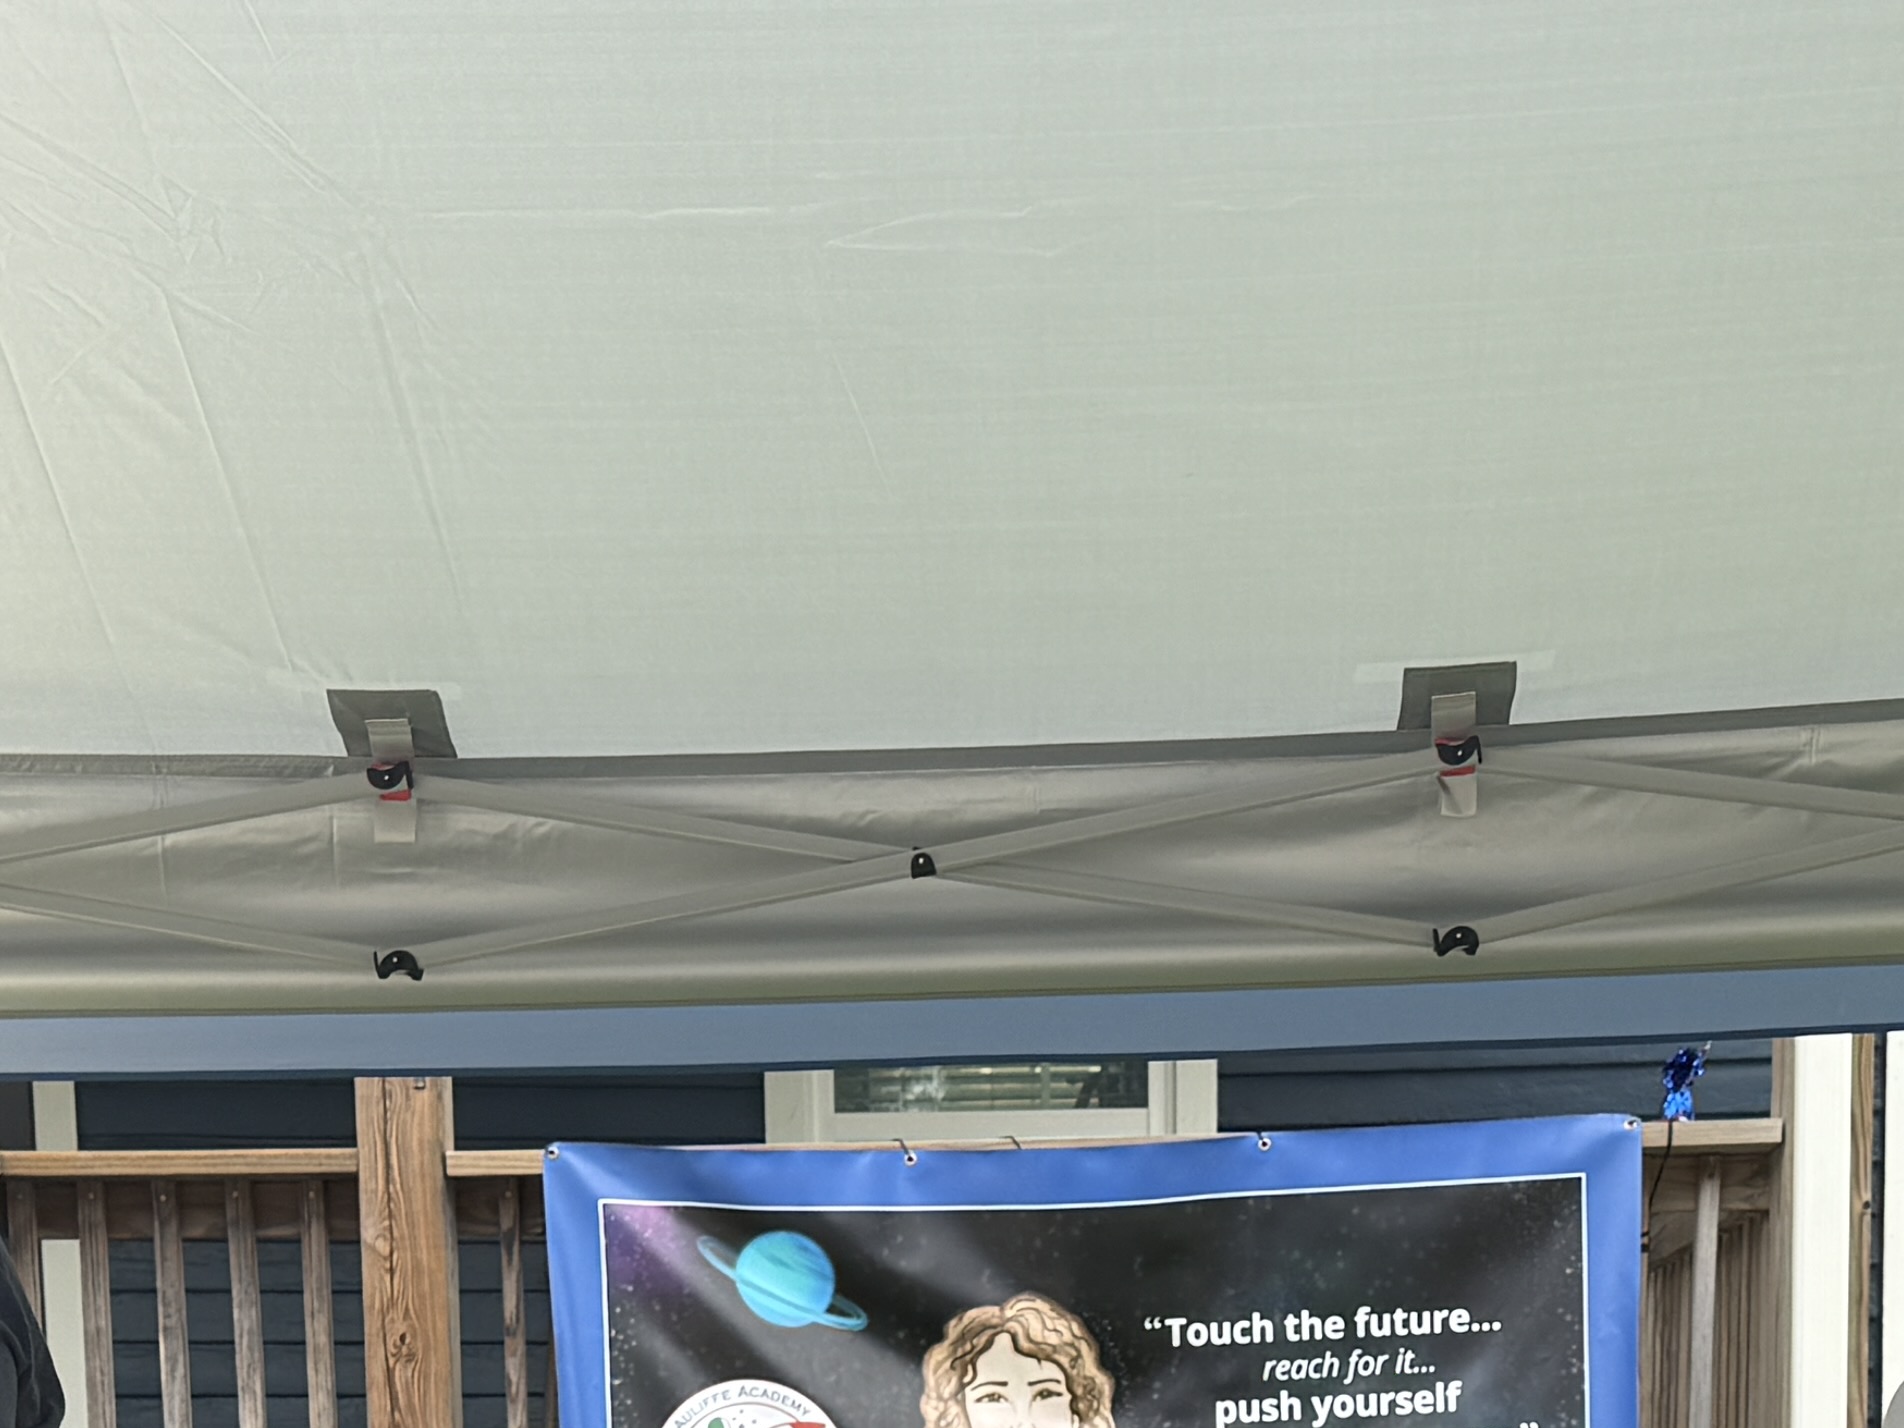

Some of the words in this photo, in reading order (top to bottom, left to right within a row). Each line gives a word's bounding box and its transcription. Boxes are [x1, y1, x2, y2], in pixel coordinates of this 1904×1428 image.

[1144, 1312, 1274, 1347] “Touch
[1284, 1309, 1345, 1342] the
[1355, 1306, 1502, 1338] future...
[1262, 1351, 1339, 1381] reach
[1344, 1348, 1388, 1384] for
[1395, 1347, 1436, 1375] it...
[737, 1385, 811, 1416] ACADEMY
[1311, 1381, 1462, 1428] yourself
